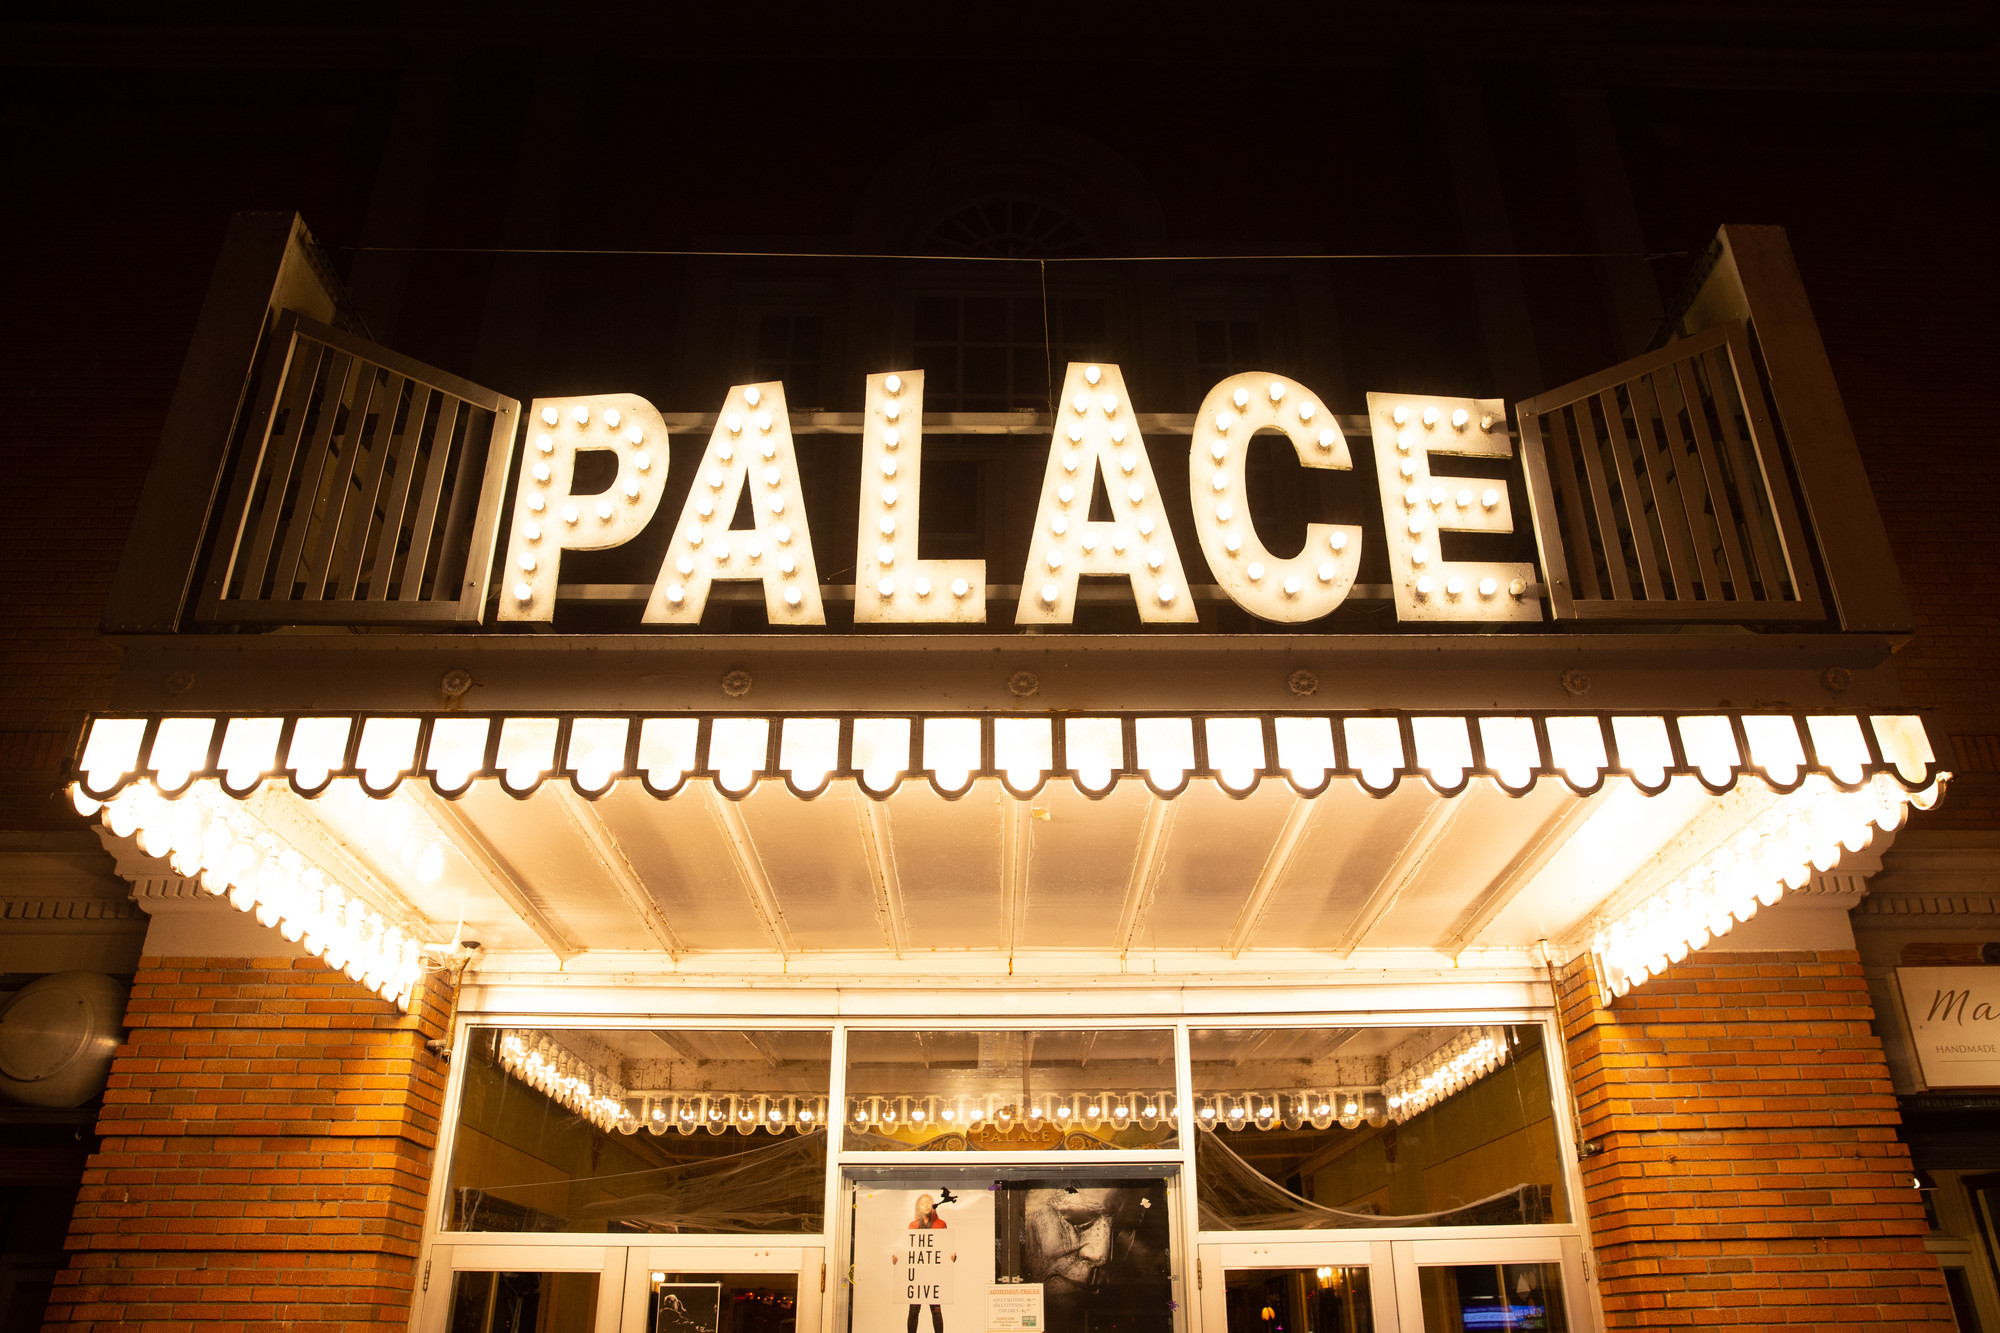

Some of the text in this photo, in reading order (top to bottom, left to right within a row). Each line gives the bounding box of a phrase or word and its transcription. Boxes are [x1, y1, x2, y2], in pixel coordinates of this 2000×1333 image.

[497, 362, 1543, 625] PALACE
[1935, 1044, 1998, 1054] HANDMADE
[979, 1130, 1052, 1143] PALACE
[909, 1233, 935, 1248] THE
[908, 1250, 942, 1264] HATE
[908, 1267, 915, 1282] U
[907, 1284, 940, 1299] GIVE
